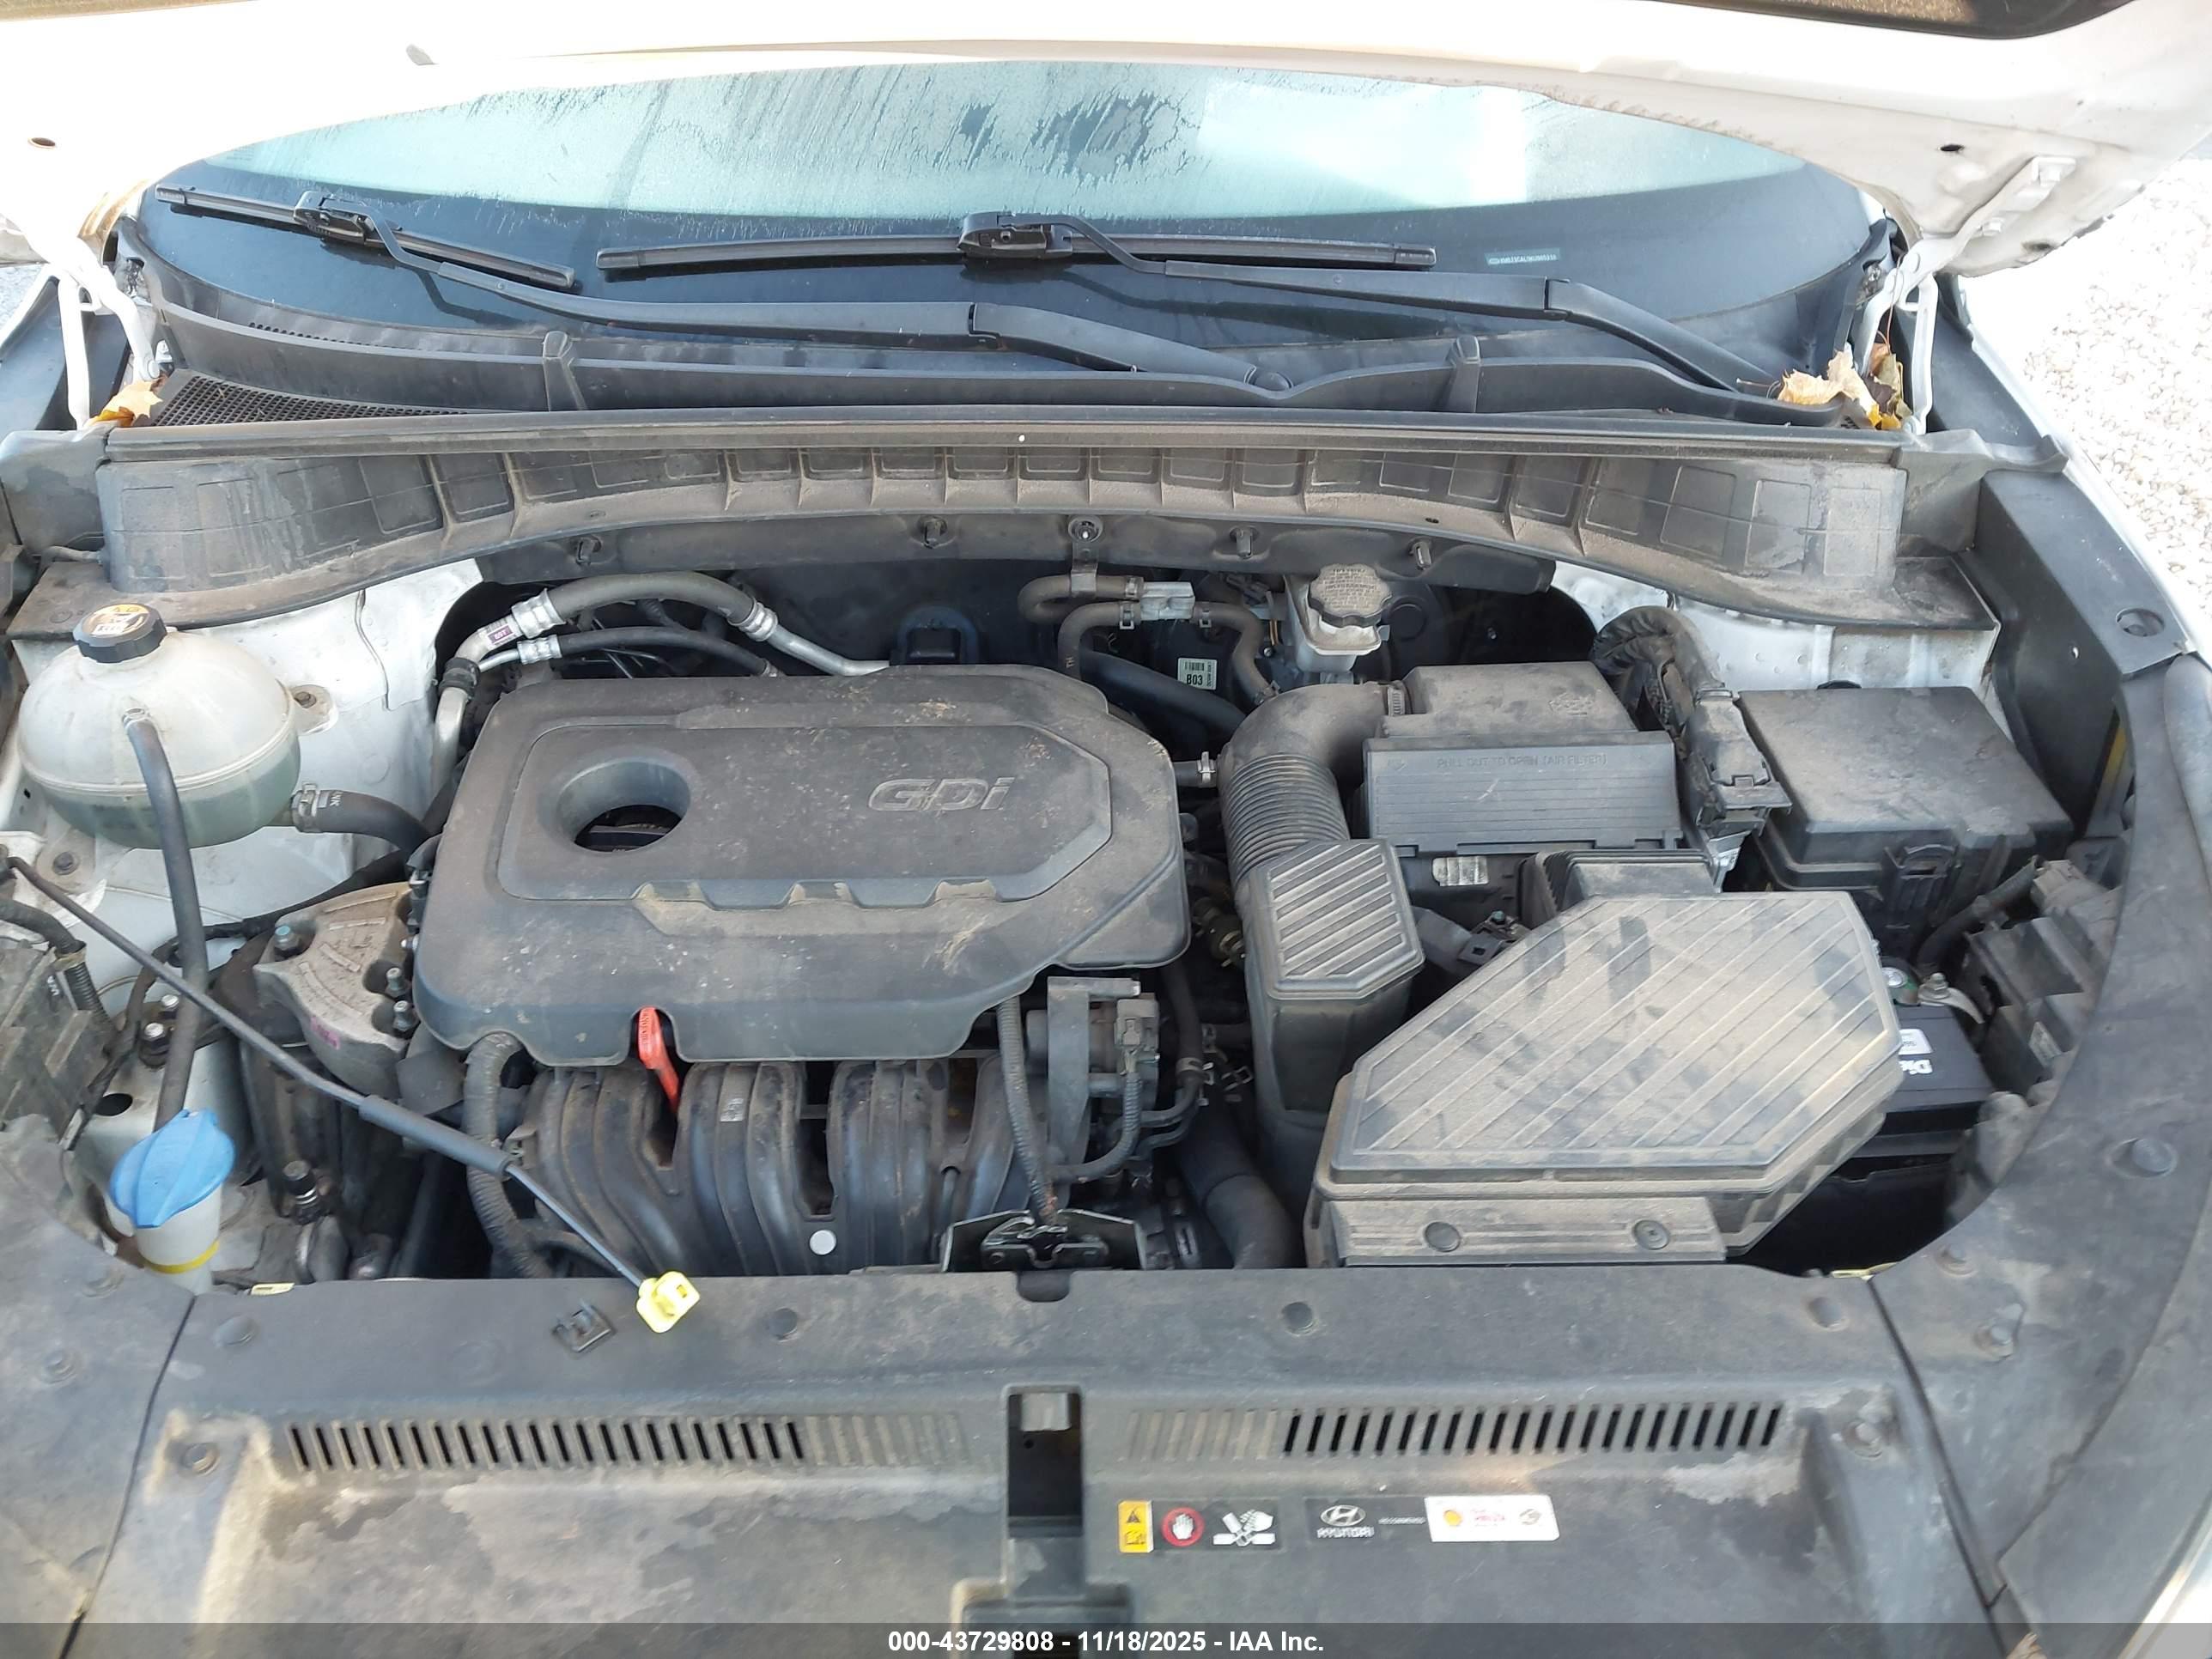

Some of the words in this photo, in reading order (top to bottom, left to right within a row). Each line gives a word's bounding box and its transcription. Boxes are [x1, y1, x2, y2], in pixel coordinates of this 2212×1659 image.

[1186, 673, 1203, 686] B03
[1436, 757, 1463, 769] PULL
[1467, 757, 1490, 768] OUT
[1492, 757, 1506, 767] TO
[1509, 756, 1539, 767] OPEN
[1544, 755, 1565, 766] (AIR
[1567, 754, 1607, 766] FILTER)
